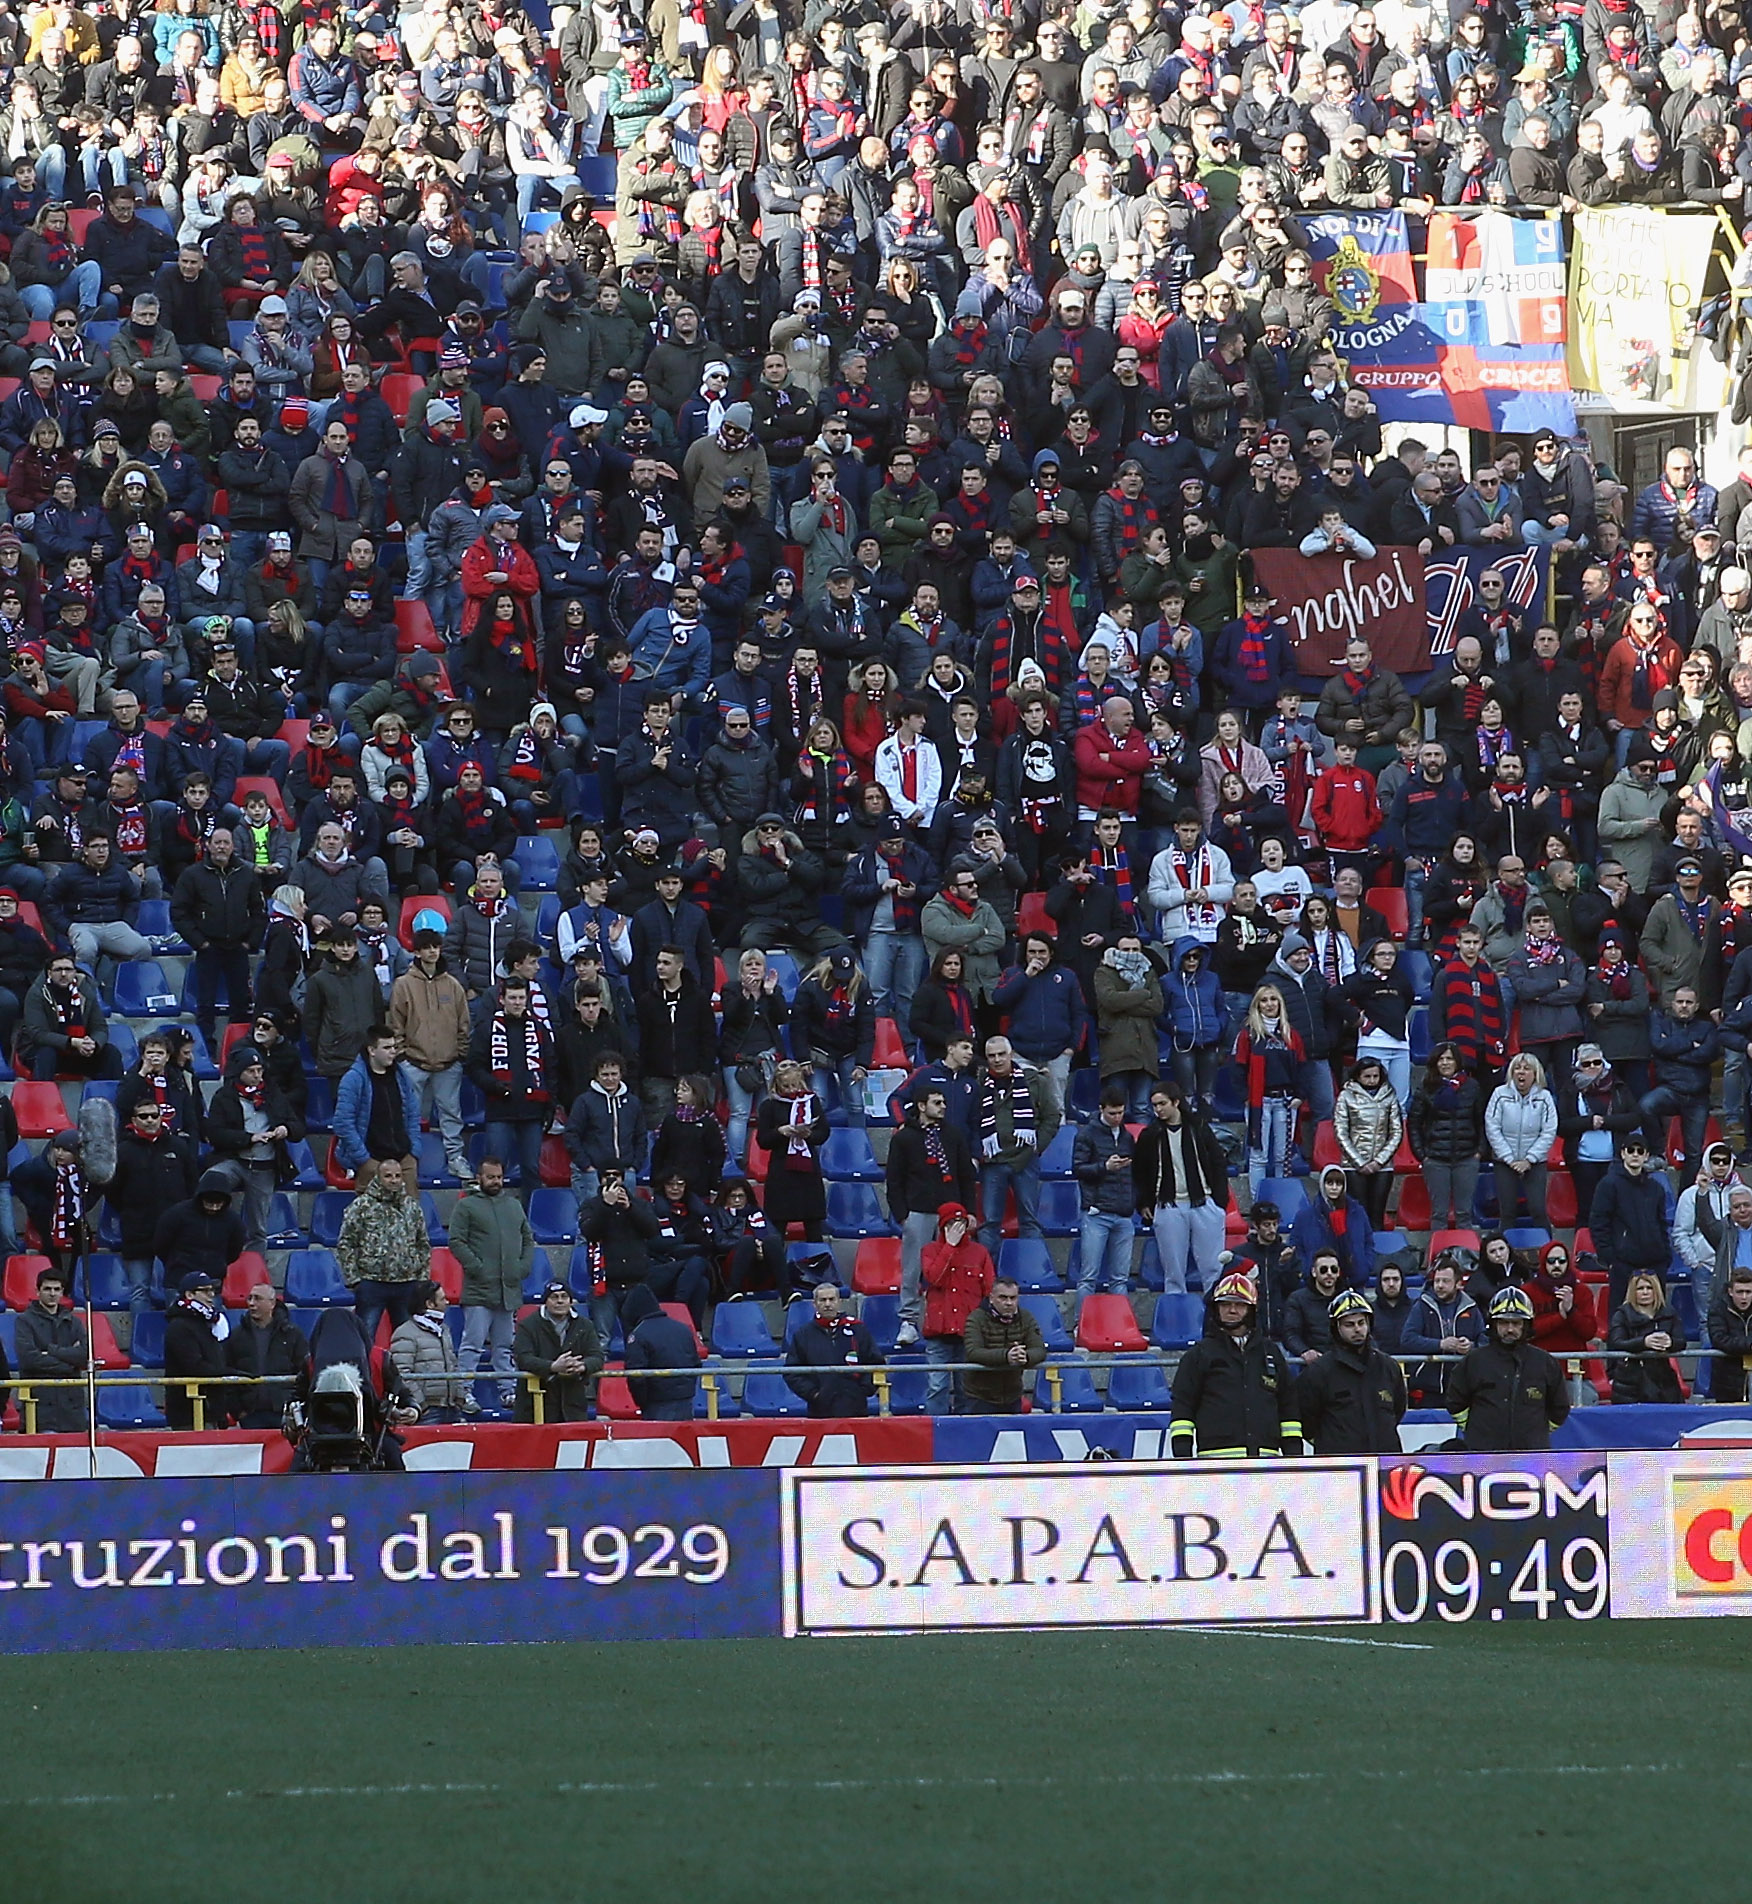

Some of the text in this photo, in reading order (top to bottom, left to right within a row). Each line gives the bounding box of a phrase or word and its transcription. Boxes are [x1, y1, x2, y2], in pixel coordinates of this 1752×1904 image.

[1305, 216, 1350, 243] NOI
[1534, 220, 1556, 253] 9
[1328, 310, 1413, 350] OLOGNA
[1575, 296, 1614, 330] VIA
[1354, 366, 1561, 387] GRUPPO CROCE
[1412, 1469, 1607, 1520] NGM
[381, 1513, 521, 1581] dal
[546, 1524, 730, 1585] 1929
[839, 1511, 1336, 1589] S.A.P.A.B.A.
[1684, 1508, 1752, 1583] C
[1384, 1537, 1608, 1623] 09:49
